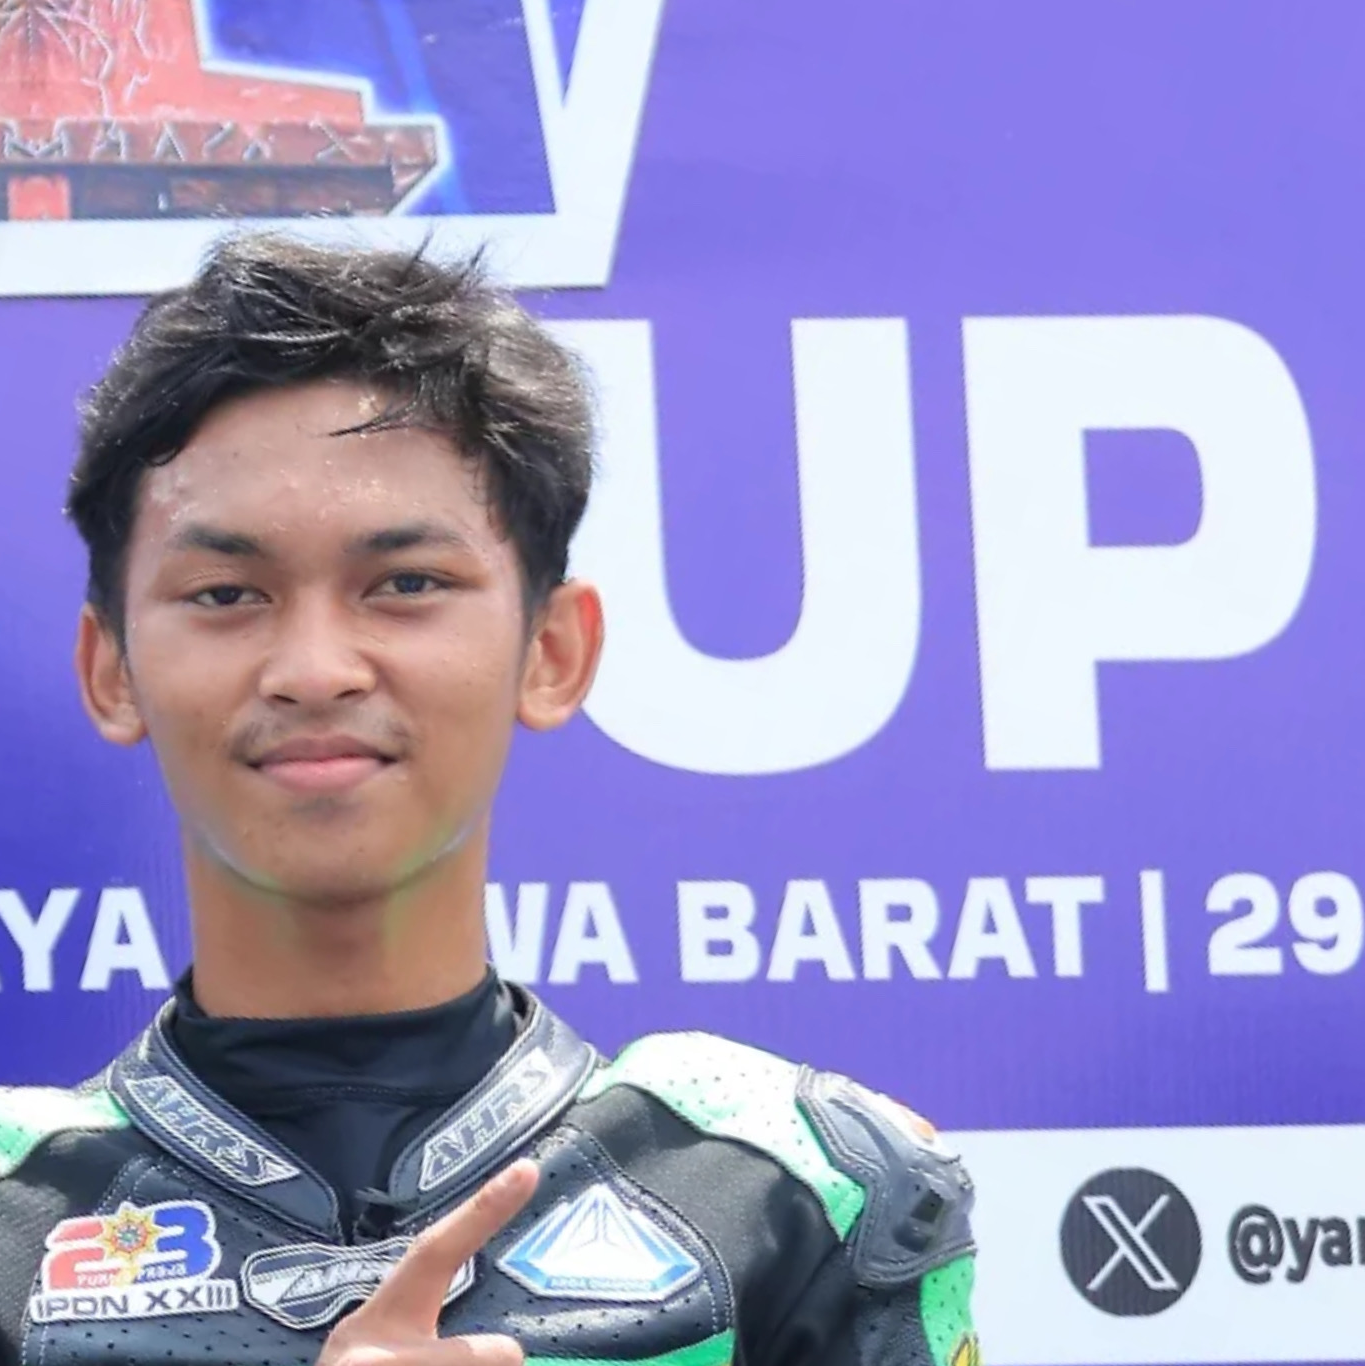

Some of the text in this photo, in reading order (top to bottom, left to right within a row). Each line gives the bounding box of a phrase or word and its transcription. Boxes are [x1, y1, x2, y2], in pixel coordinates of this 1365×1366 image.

[677, 876, 1106, 983] BARAT
[1205, 871, 1364, 977] 29
[1227, 1202, 1365, 1285] @ya
[35, 1284, 234, 1318] IPDN XXIII
